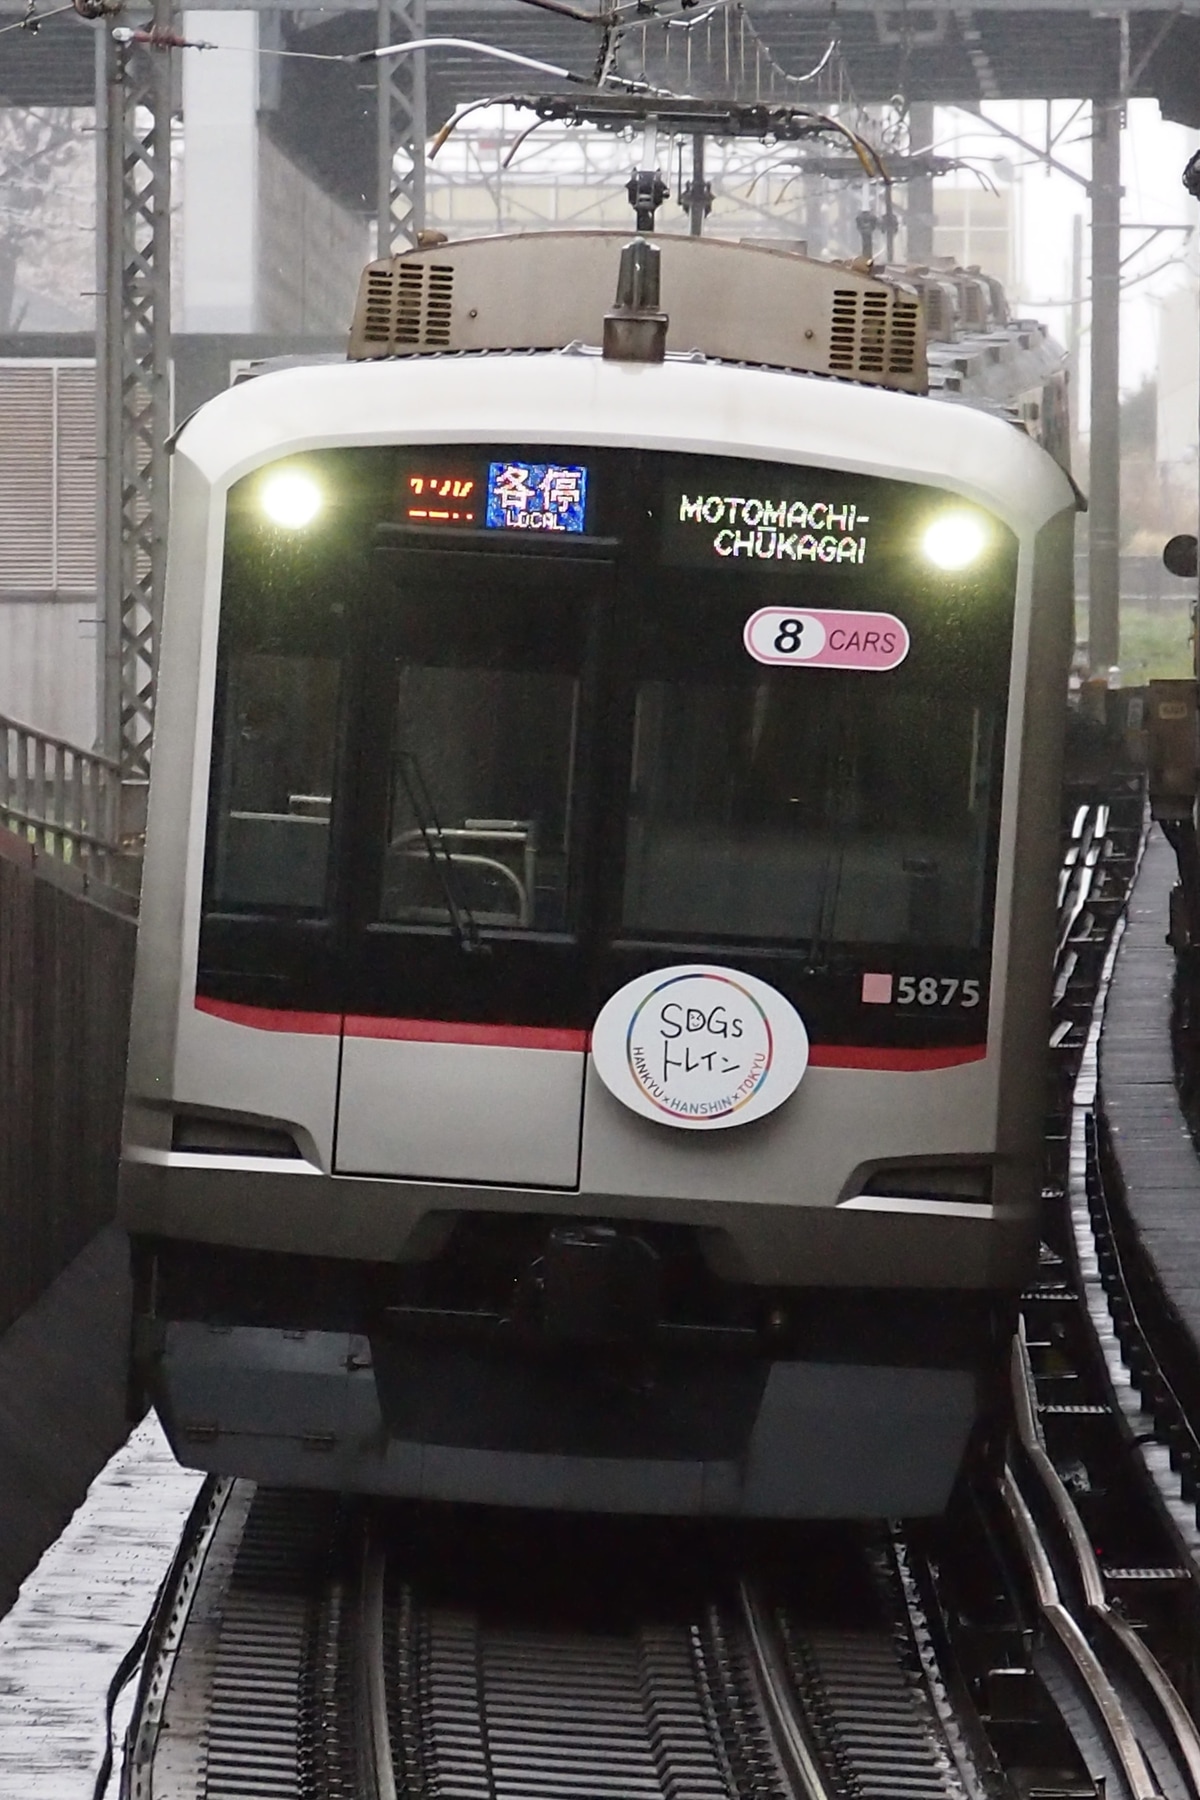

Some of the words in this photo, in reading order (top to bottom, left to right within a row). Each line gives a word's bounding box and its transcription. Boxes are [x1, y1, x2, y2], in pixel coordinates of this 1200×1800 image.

[494, 466, 581, 512] 各停
[506, 510, 566, 531] LOCAL
[679, 495, 870, 531] MOTOMACHI-
[714, 526, 867, 564] CHŪKAGAI
[773, 618, 805, 655] 8
[828, 629, 897, 654] CARS
[896, 976, 981, 1008] 5875
[660, 1003, 743, 1039] SDGs
[663, 1040, 740, 1082] トレイン
